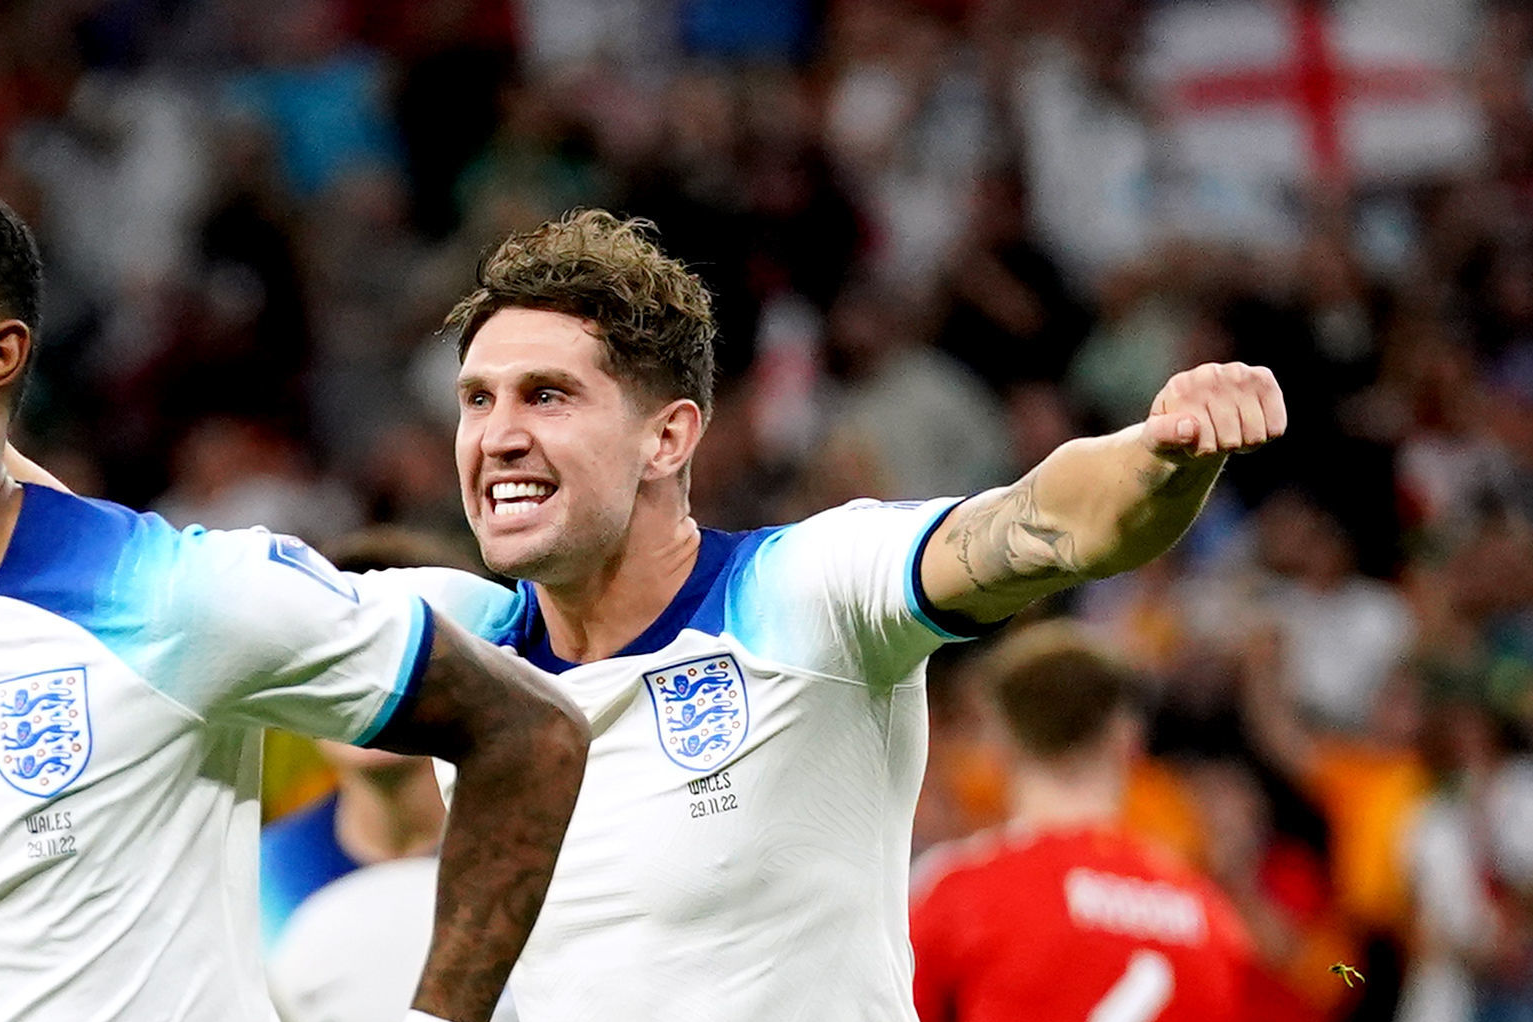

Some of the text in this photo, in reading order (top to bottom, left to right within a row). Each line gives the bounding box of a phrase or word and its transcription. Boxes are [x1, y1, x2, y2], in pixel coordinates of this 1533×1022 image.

[687, 772, 732, 796] WALES
[689, 793, 739, 819] 29.11.22
[26, 812, 72, 834] WALES
[27, 834, 77, 858] 29.11.22
